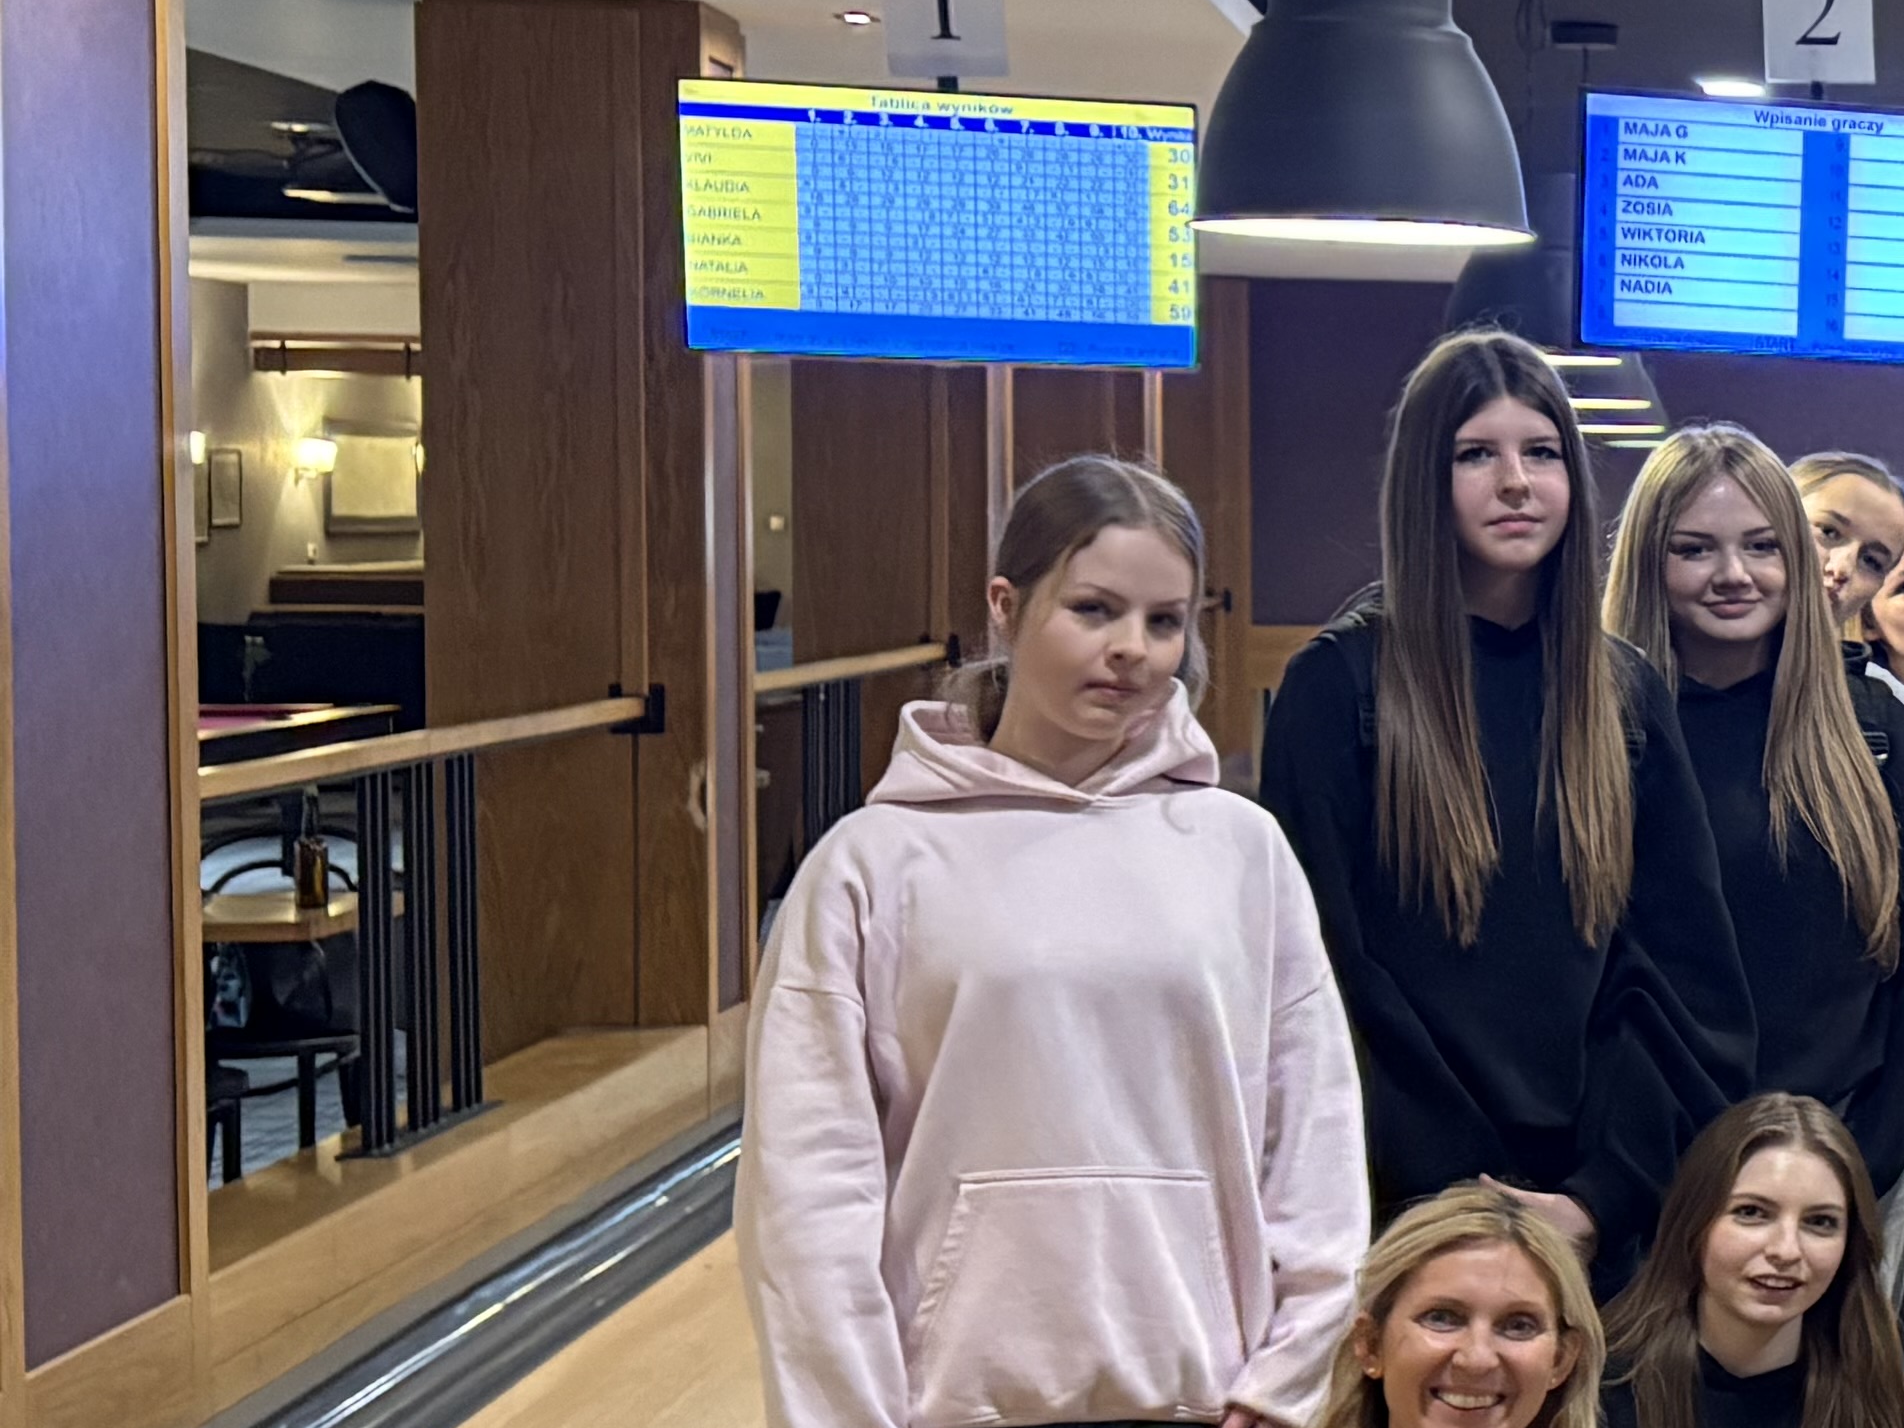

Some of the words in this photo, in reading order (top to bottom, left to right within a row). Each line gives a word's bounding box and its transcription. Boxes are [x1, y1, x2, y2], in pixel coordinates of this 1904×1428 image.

[1623, 121, 1673, 138] MAJA
[1675, 126, 1689, 140] G
[1753, 109, 1827, 129] Wpisanie
[1832, 116, 1884, 134] graczy
[1623, 147, 1672, 164] MAJA
[1673, 151, 1687, 166] K
[1168, 174, 1190, 190] 31
[1622, 174, 1659, 190] ADA
[1621, 200, 1674, 218] ZOSIA
[1621, 227, 1706, 245] WIKTORIA
[1620, 253, 1685, 270] NIKOLA
[1169, 279, 1191, 295] 41
[1619, 278, 1673, 296] NADIA
